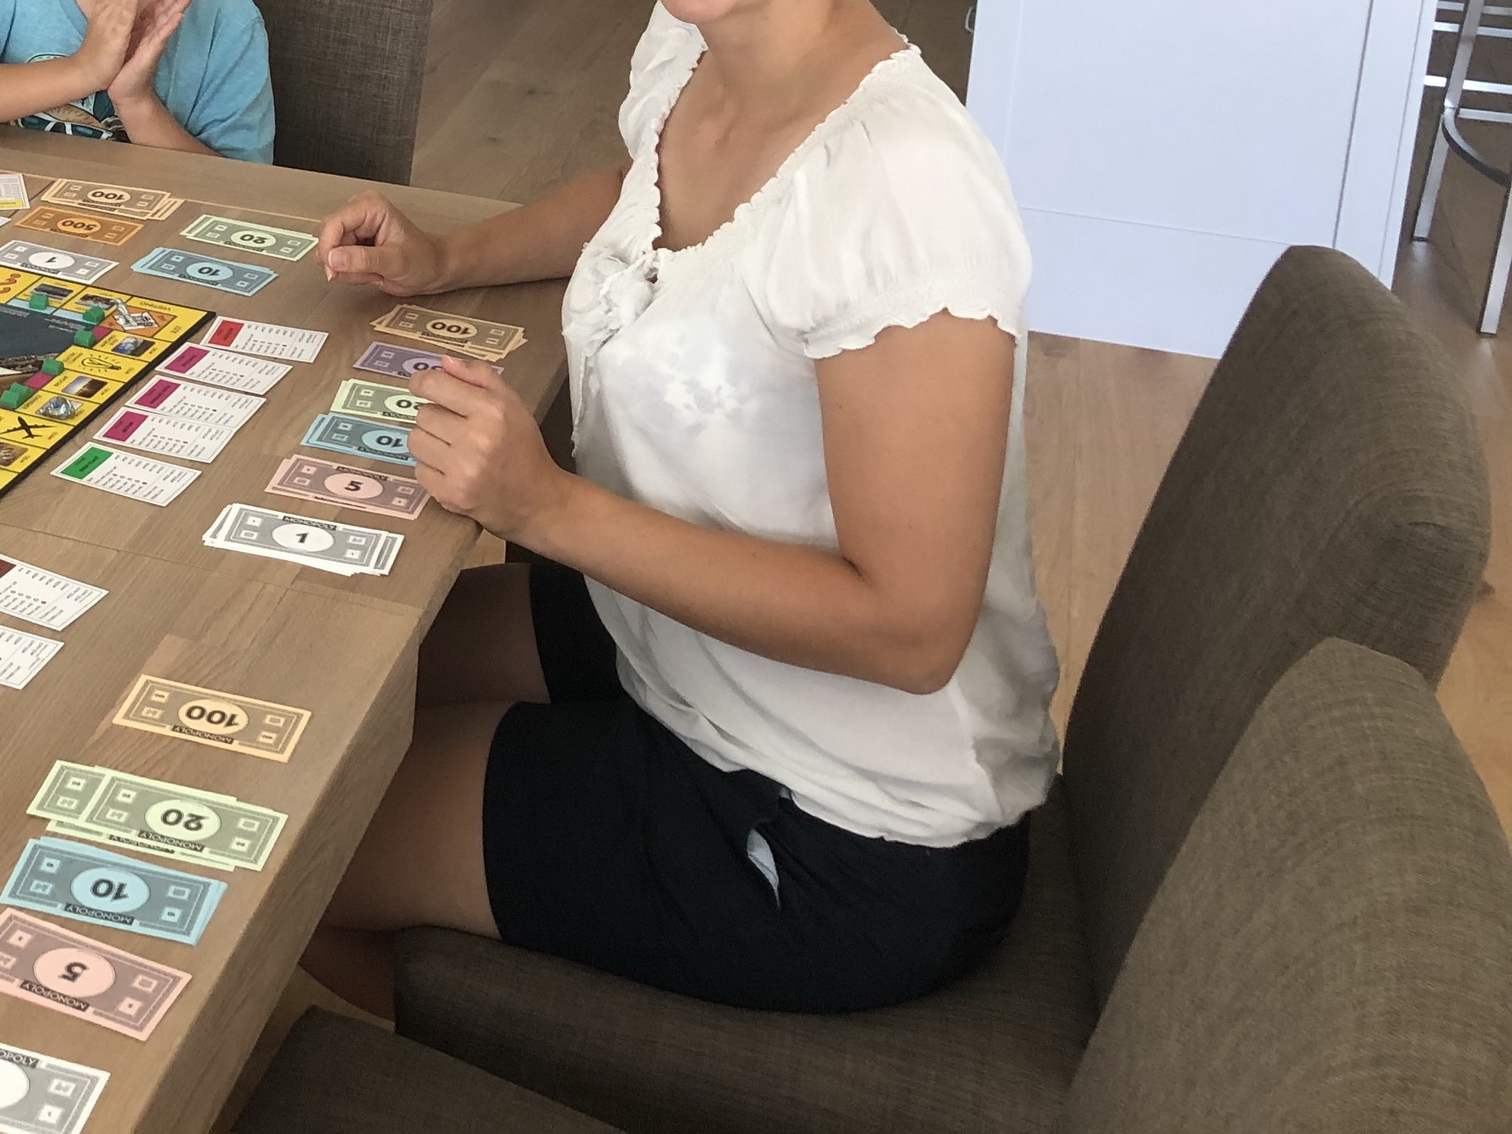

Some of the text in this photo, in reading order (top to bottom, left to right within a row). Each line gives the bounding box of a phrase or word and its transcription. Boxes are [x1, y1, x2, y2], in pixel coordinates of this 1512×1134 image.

[91, 190, 125, 202] 100
[62, 220, 94, 232] 500
[239, 233, 267, 244] 20
[197, 266, 220, 277] 10
[431, 322, 472, 336] 100
[375, 435, 405, 449] 10
[344, 480, 364, 493] 5
[285, 517, 336, 531] MONOPOLY
[294, 531, 310, 545] 1
[186, 705, 240, 728] 100
[174, 725, 233, 744] MONOPOLY
[161, 808, 210, 832] 20
[140, 830, 203, 852] MONOPOLY
[91, 878, 129, 902] 10
[66, 903, 133, 926] MONOPOLY
[58, 961, 90, 983] 5
[23, 980, 87, 1011] MONOPOLY
